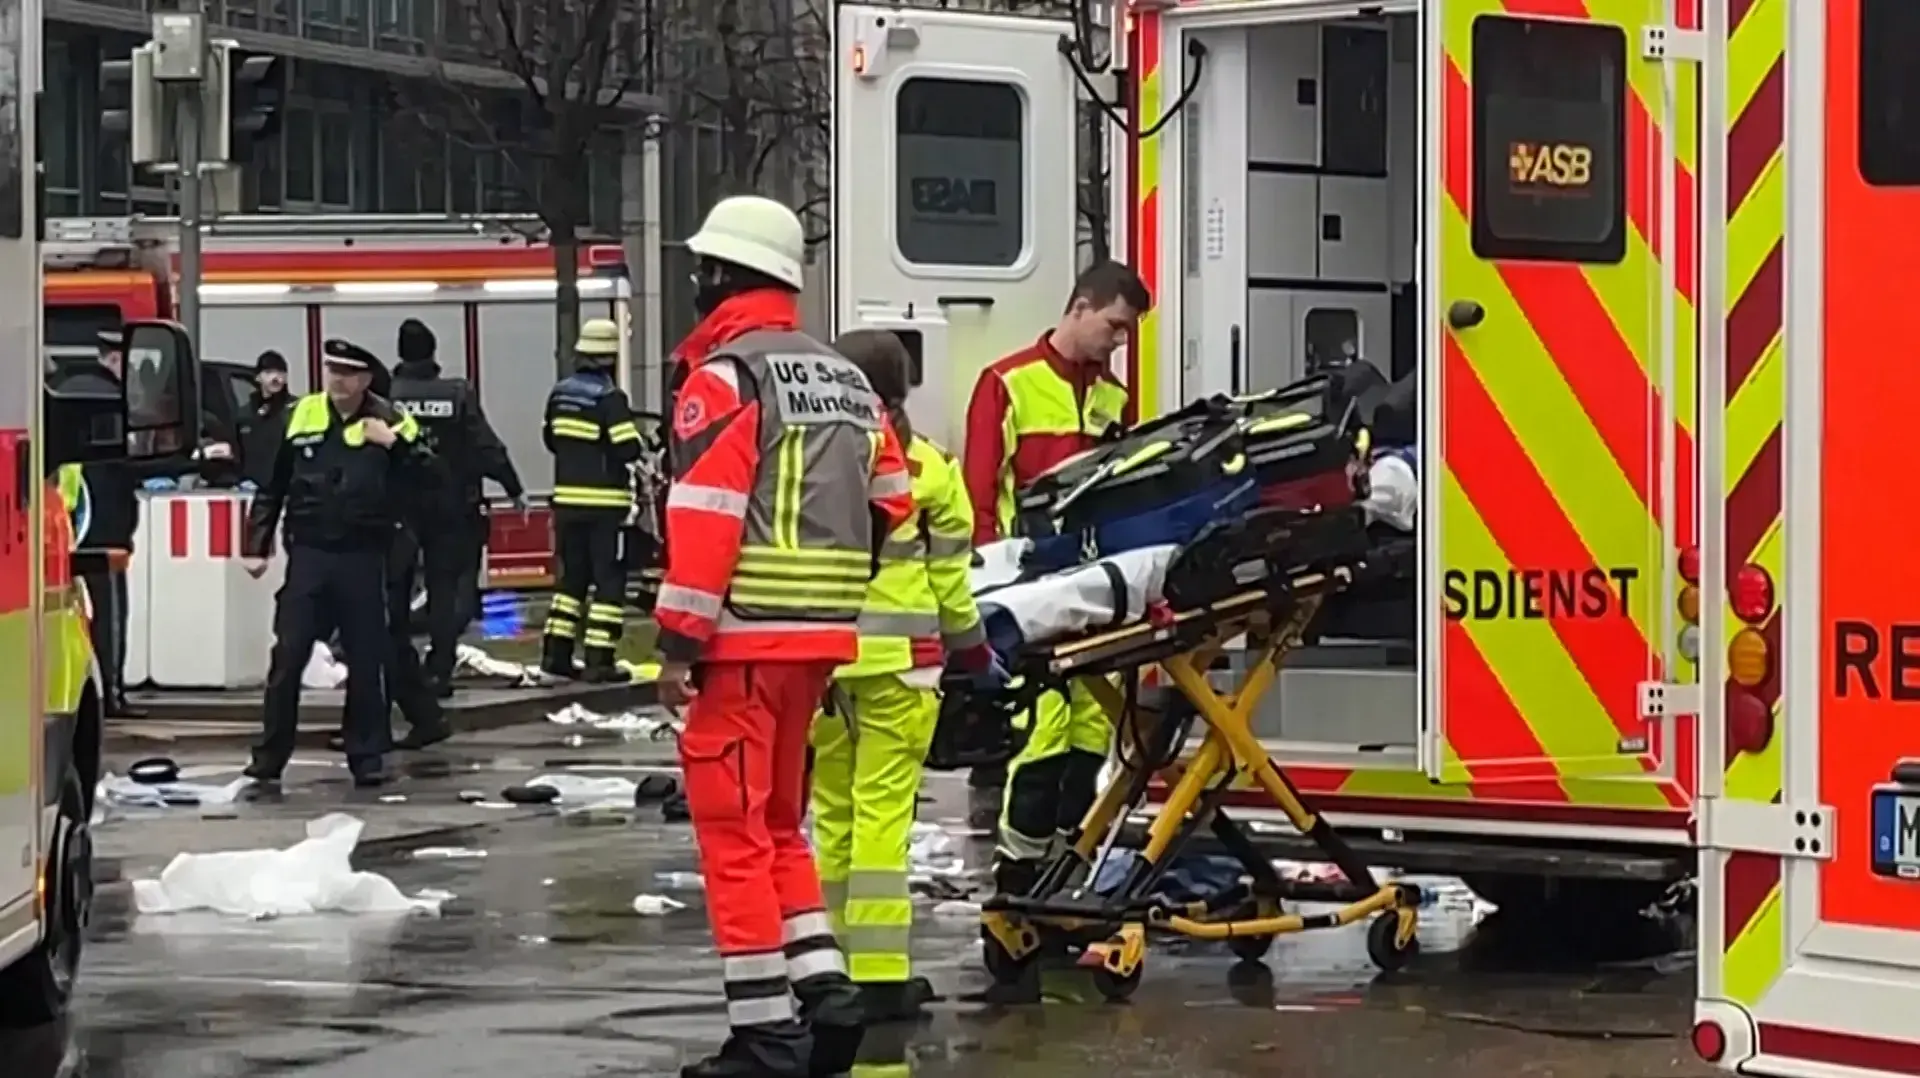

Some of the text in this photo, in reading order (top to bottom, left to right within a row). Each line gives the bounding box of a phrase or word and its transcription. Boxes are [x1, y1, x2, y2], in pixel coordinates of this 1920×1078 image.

[1530, 144, 1592, 185] ASB
[774, 361, 809, 385] UG
[1443, 567, 1639, 620] SDIENST
[1834, 620, 1920, 702] RE
[1899, 802, 1920, 859] M
